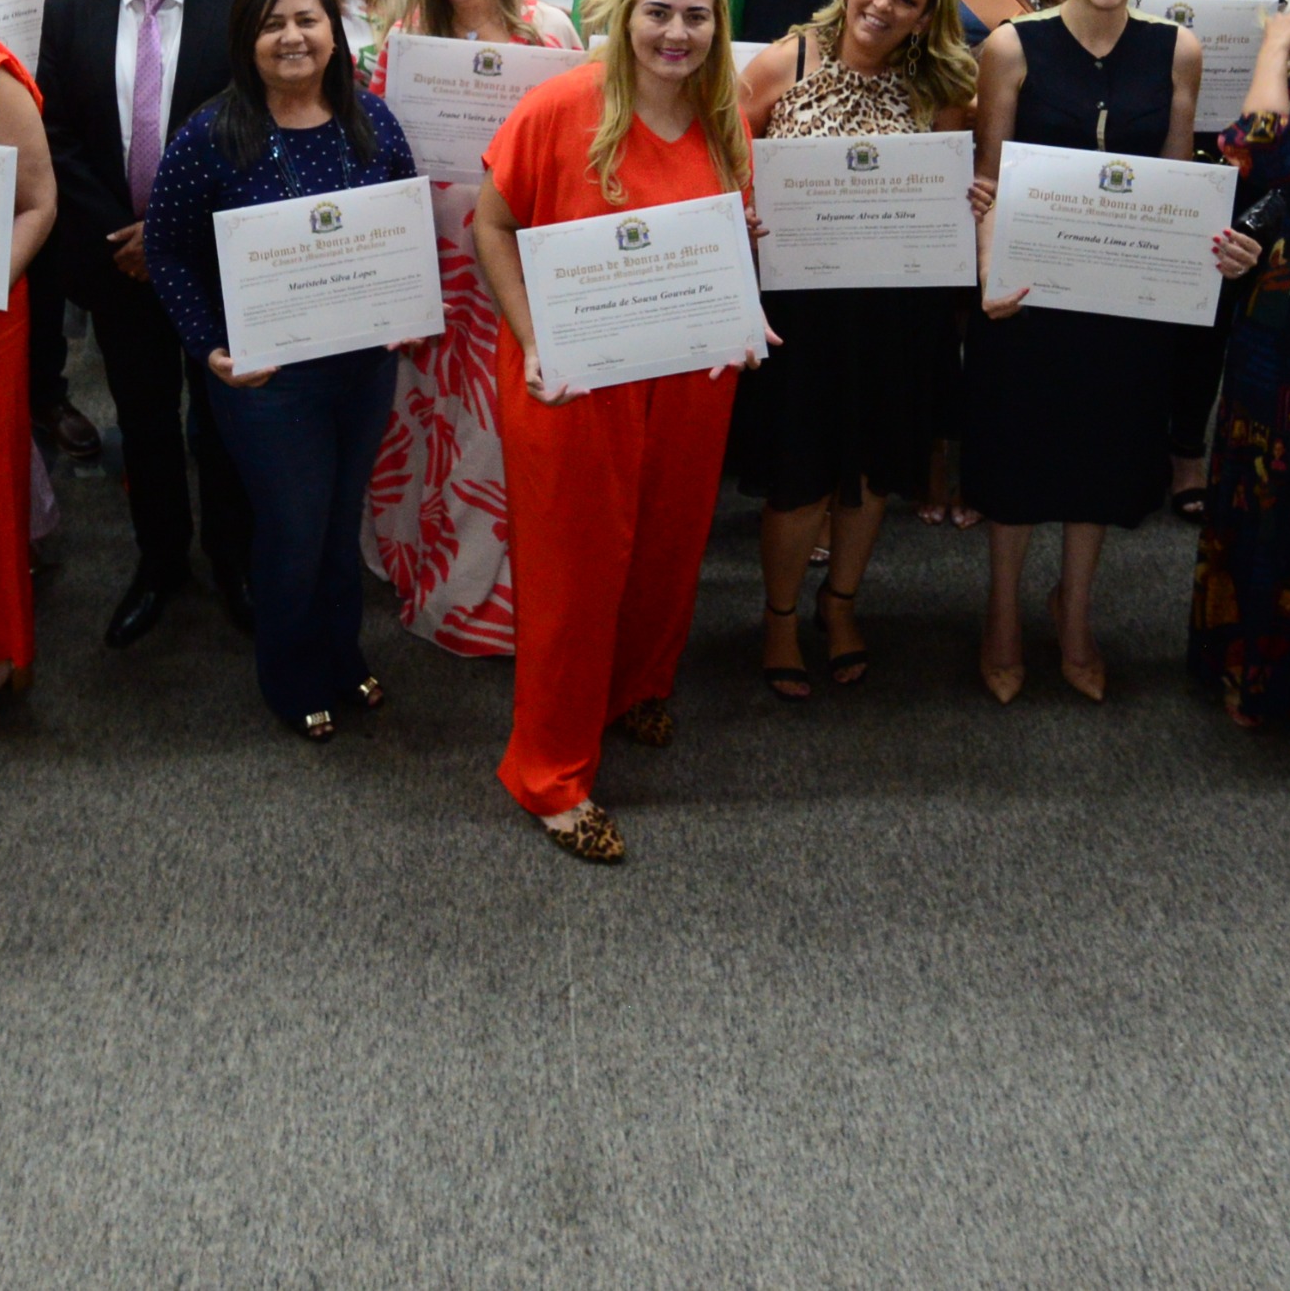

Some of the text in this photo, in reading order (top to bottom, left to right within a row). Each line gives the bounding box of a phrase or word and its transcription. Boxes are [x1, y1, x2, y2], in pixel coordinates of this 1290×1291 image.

[413, 73, 456, 88] Diploma
[459, 78, 470, 88] de
[473, 78, 507, 92] Honra
[783, 173, 945, 190] Diploma de Honra ao Mérito
[857, 212, 880, 220] Alves
[881, 212, 893, 220] da
[895, 211, 916, 219] Silva
[1028, 187, 1200, 219] Diploma de Honra ao Mérito
[248, 225, 407, 263] Diploma de Honra ao Mérito
[1057, 231, 1102, 245] Fernanda
[1103, 234, 1127, 247] Lima
[1136, 239, 1160, 251] Silva
[553, 243, 720, 280] Diploma de Honra ao Mérito
[288, 268, 378, 293] Maristela Silva Lopes
[574, 283, 714, 315] Fernanda de Sousa Gouveia Pio
